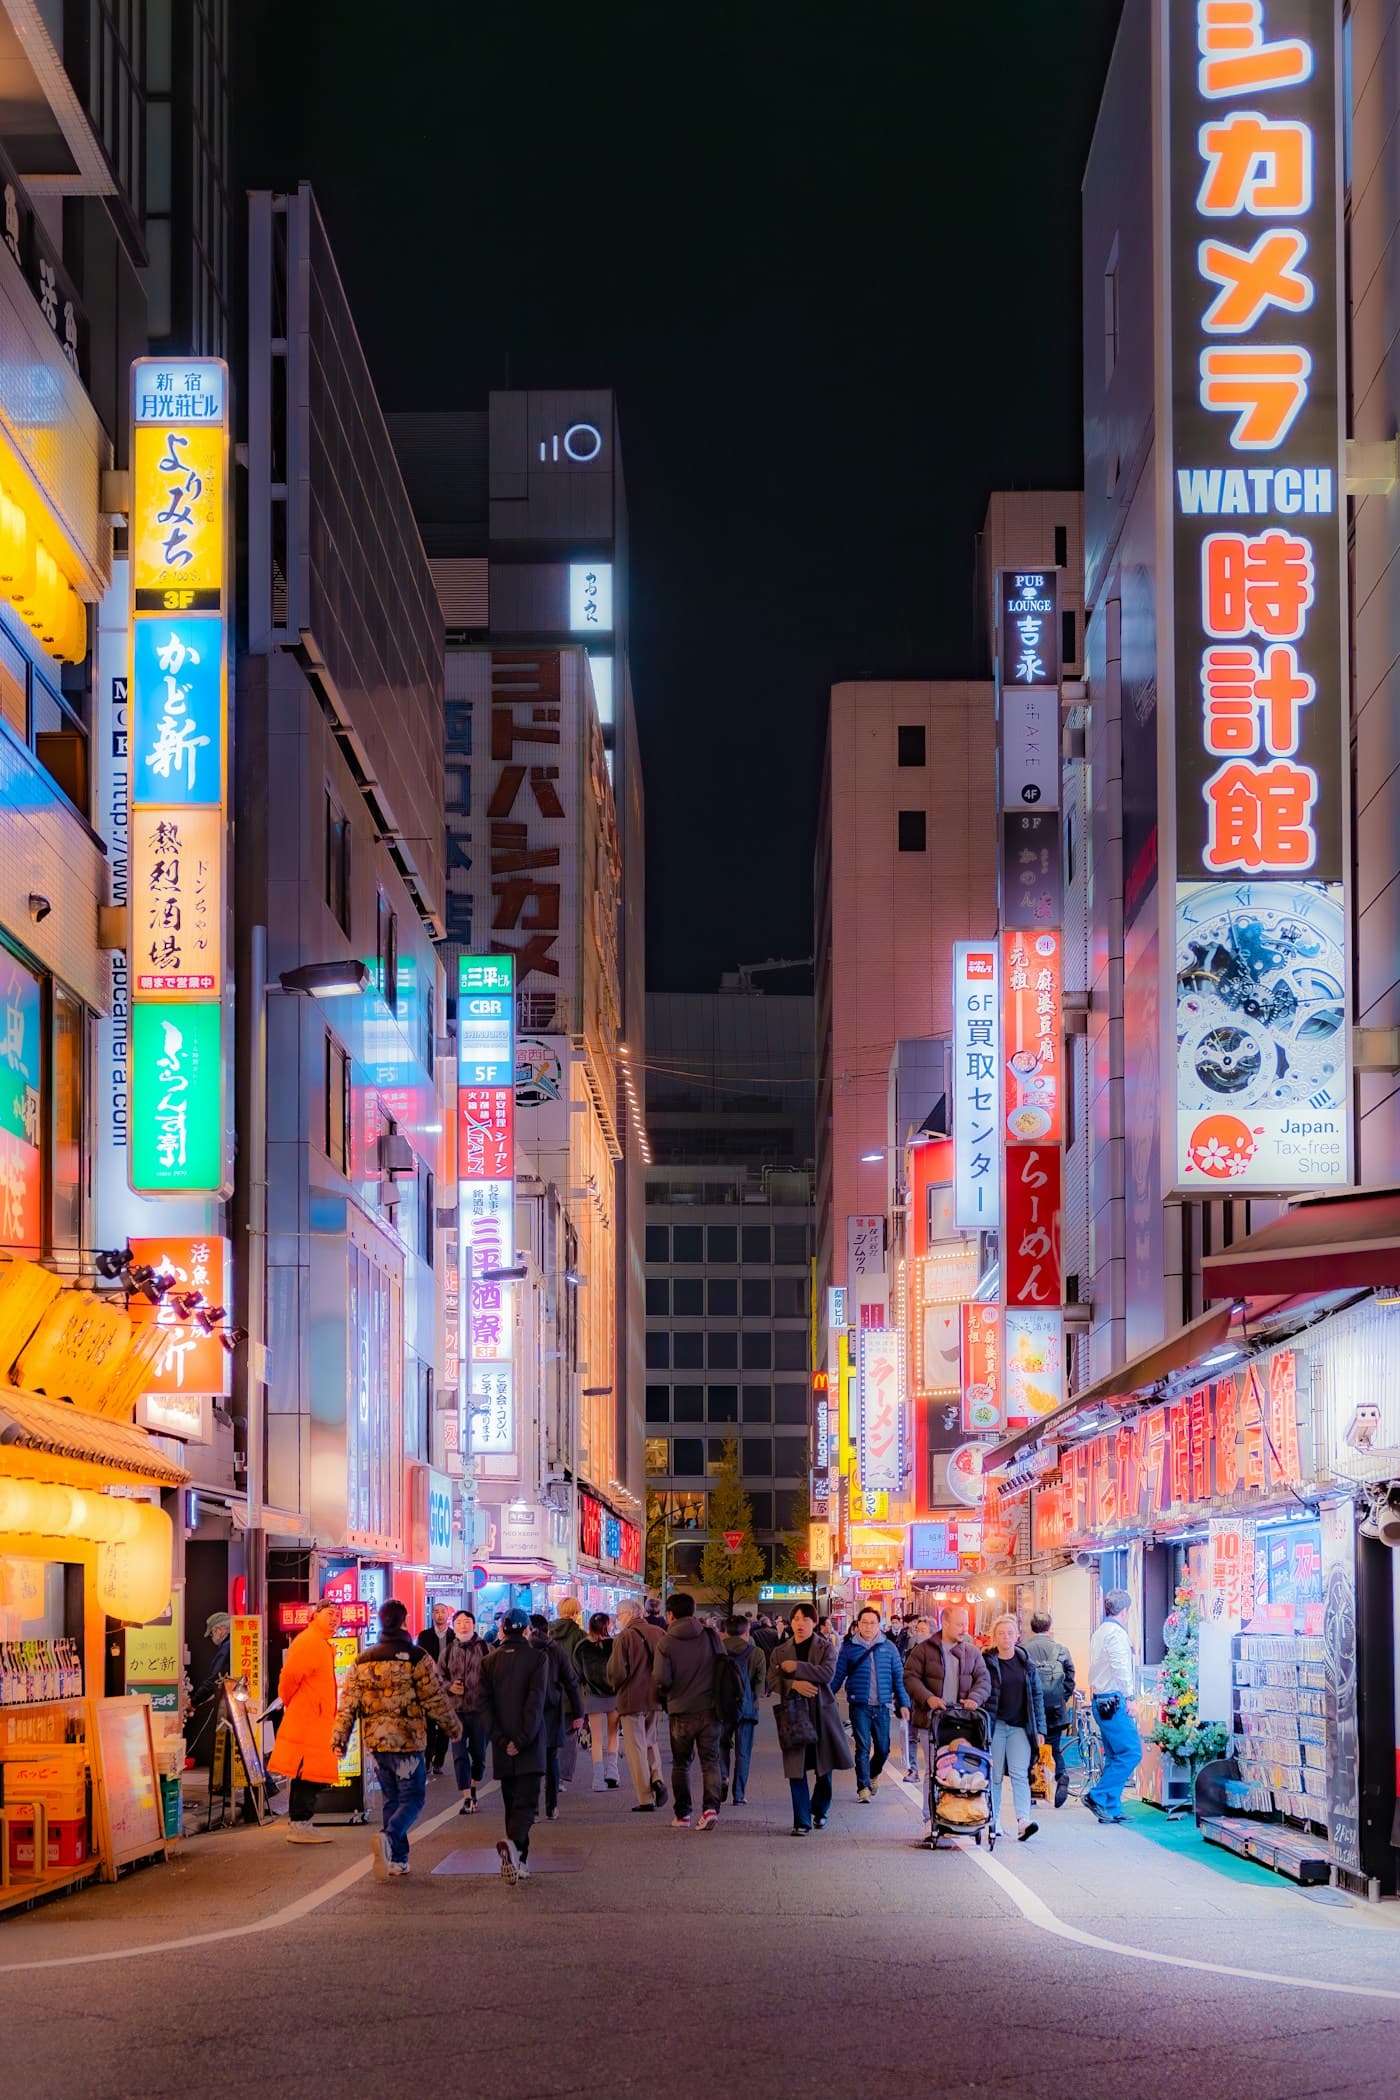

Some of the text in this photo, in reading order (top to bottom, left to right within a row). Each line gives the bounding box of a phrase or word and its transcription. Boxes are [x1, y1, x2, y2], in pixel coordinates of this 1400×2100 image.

[1195, 0, 1313, 450] シカメラ
[156, 373, 202, 391] 新宿
[156, 432, 203, 568] よりみち
[1177, 468, 1333, 514] WATCH
[1015, 575, 1044, 587] PUB
[164, 590, 196, 609] 3F
[1008, 600, 1051, 612] LOUNGE
[1016, 615, 1046, 685] 吉永
[145, 631, 211, 792] かど新
[1198, 527, 1318, 872] 時計館
[1024, 788, 1038, 800] 4F
[148, 821, 183, 970] 熱烈酒場
[469, 1000, 502, 1014] CBR
[967, 994, 993, 1011] 6F
[475, 1066, 498, 1081] 5F
[966, 1019, 995, 1213] 買取センター
[1280, 1119, 1340, 1136] Japan.
[494, 1131, 508, 1174] シーアン
[1273, 1139, 1340, 1155] Tax-free
[1298, 1158, 1340, 1175] Shop
[1017, 1151, 1052, 1301] らーめん
[869, 1356, 895, 1459] ラーメン
[1211, 1531, 1240, 1560] 10
[130, 1657, 177, 1673] かど新
